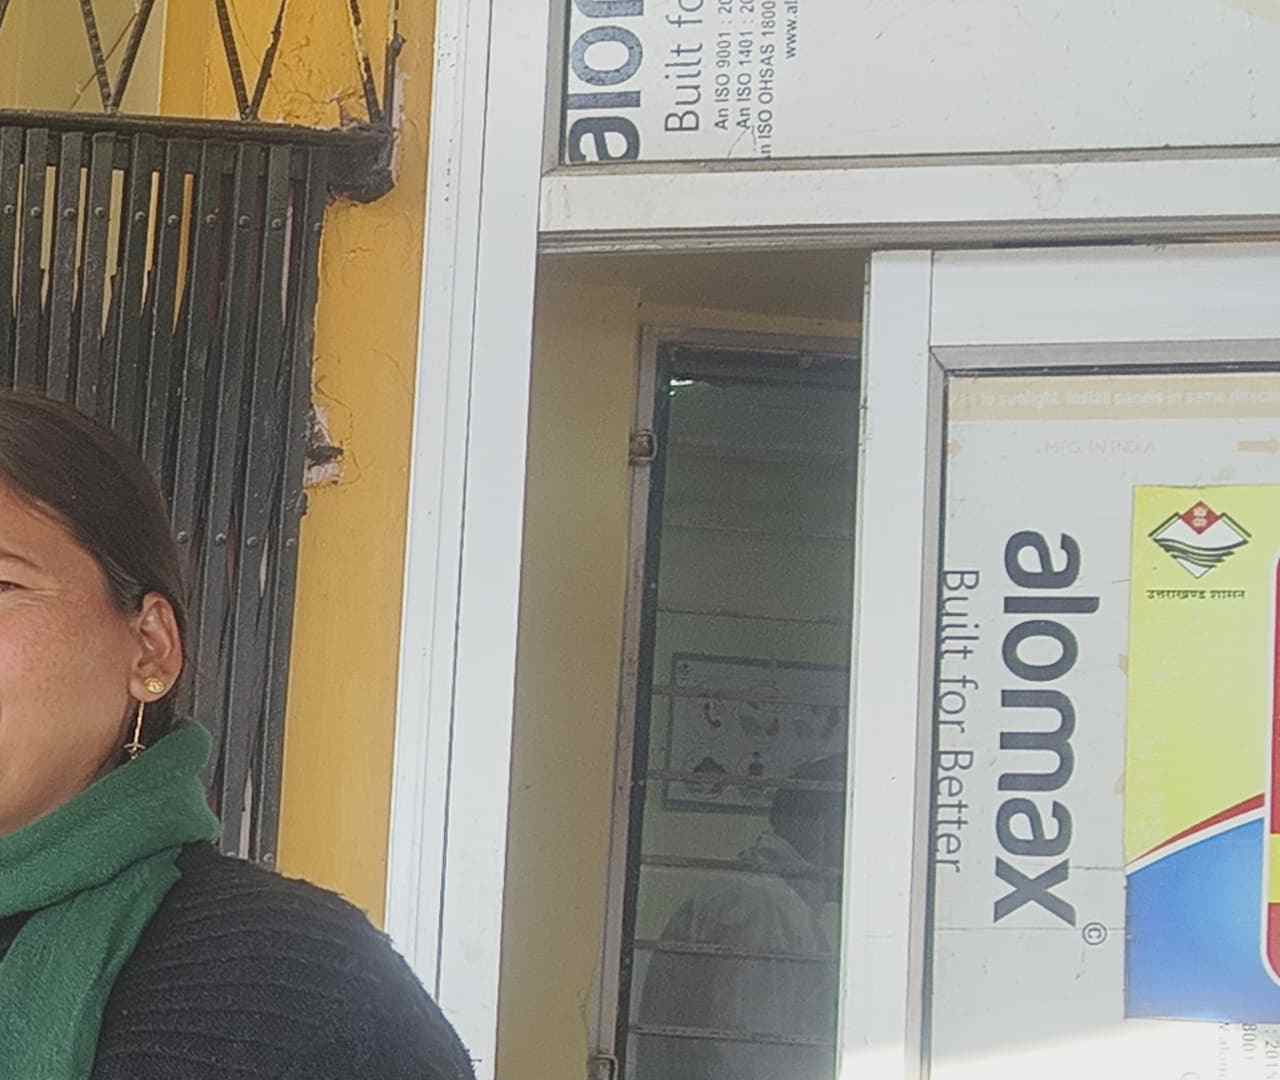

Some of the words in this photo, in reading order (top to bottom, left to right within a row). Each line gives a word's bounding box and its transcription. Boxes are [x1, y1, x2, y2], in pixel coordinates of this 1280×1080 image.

[716, 31, 732, 68] 9001
[738, 31, 754, 66] 1401
[567, 0, 644, 163] alo
[665, 42, 704, 132] Built
[714, 73, 731, 102] ISO
[736, 73, 752, 102] ISO
[757, 43, 775, 105] OHSAS
[714, 107, 729, 131] An
[736, 107, 751, 130] An
[757, 109, 773, 139] ISO
[940, 570, 980, 661] Built
[938, 675, 979, 734] for
[993, 529, 1101, 928] alomax
[936, 750, 975, 873] Better
